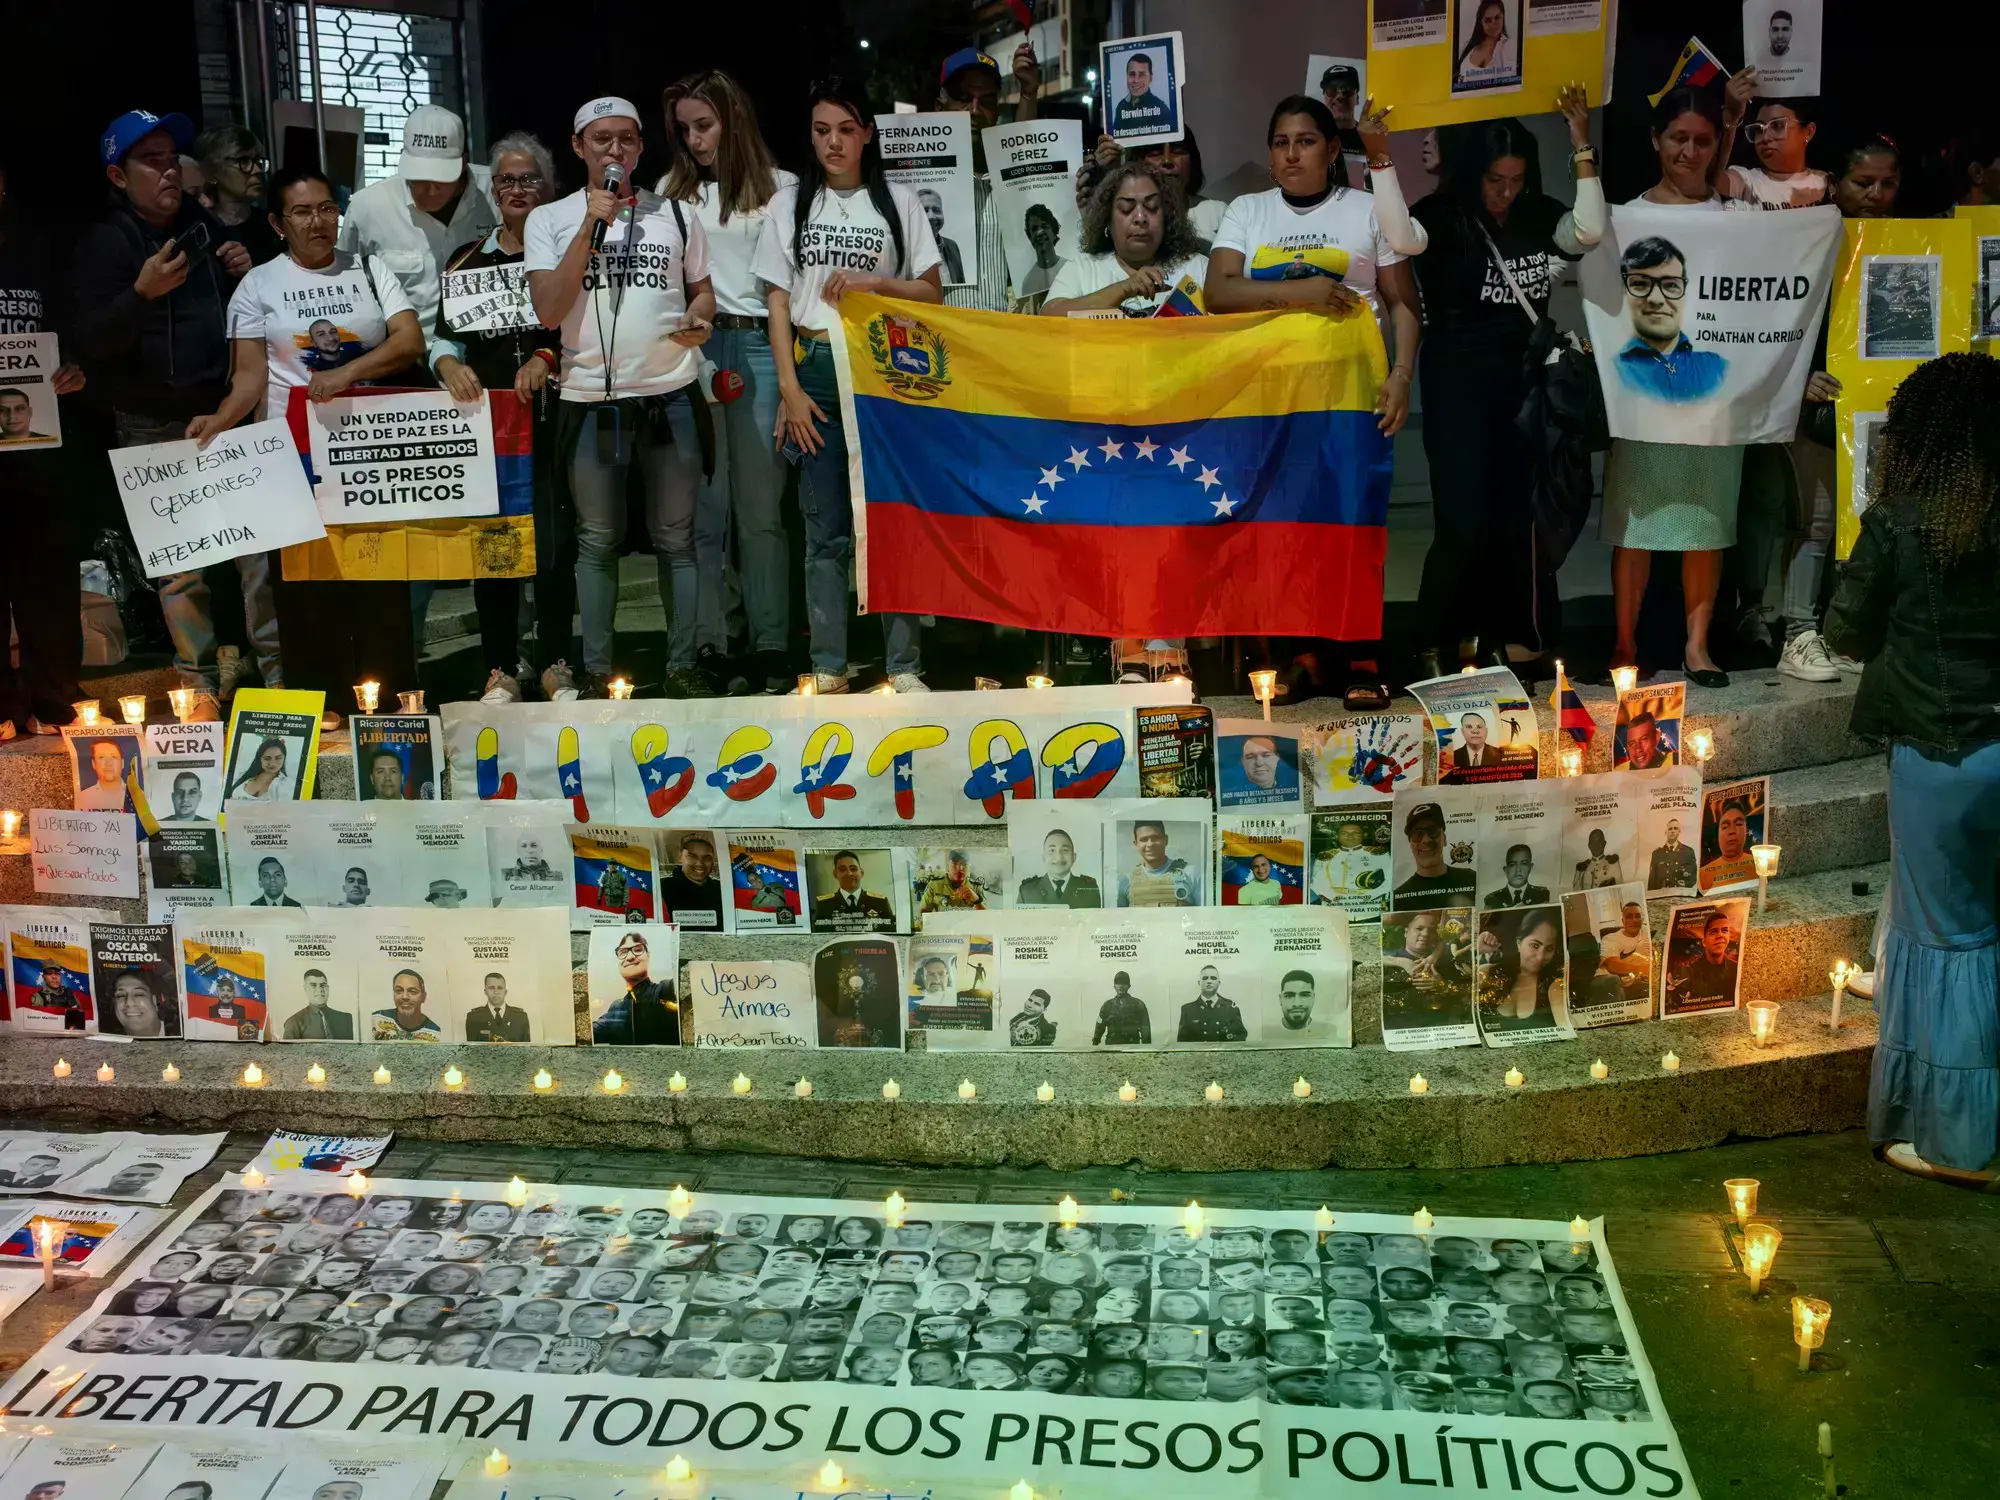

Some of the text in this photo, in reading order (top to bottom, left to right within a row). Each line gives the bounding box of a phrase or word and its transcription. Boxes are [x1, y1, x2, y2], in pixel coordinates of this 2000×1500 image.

[1122, 108, 1142, 119] Darwin
[878, 126, 952, 139] FERNANDO
[412, 134, 447, 149] PETARE
[1001, 132, 1058, 149] RODRIGO
[885, 142, 946, 154] SERRANO
[1011, 149, 1048, 162] PÉREZ
[840, 225, 884, 238] A TODOS
[633, 244, 670, 255] TODOS
[826, 234, 883, 253] PRESOS
[606, 255, 669, 270] PRESOS
[583, 270, 667, 291] OLÍTICOS
[284, 284, 360, 302] LIBEREN A
[1699, 276, 1810, 301] LIBERTAD
[298, 303, 353, 318] POLITICOS
[1697, 313, 1716, 321] PARA
[1696, 330, 1754, 343] JONATHAN
[341, 408, 460, 427] UN VERDADERO
[328, 423, 472, 443] ACTO DE PAZ ES LA
[330, 442, 476, 462] LIBERTAD DE TODOS
[123, 457, 188, 490] ¿DÓNDE
[255, 436, 284, 455] LOS
[341, 464, 465, 485] LOS PRESOS
[151, 467, 262, 524] GEDEONES?
[344, 483, 465, 506] POLÍTICOS
[1429, 702, 1460, 713] JUSTO
[360, 720, 425, 728] Ricardo Cariel
[1140, 714, 1177, 725] ES AHORA
[154, 725, 212, 735] JACKSON
[1149, 722, 1180, 732] NUNCA
[359, 732, 428, 745] ¡LIBERTAD!
[155, 739, 214, 754] VERA
[1143, 748, 1179, 760] LIBERTAD
[1144, 756, 1179, 766] PARA TODOS
[475, 718, 1126, 824] LIBERTAD
[1599, 802, 1618, 810] SILVA
[1673, 801, 1697, 809] PLAZA
[37, 817, 120, 835] LIBERTAD YA!
[27, 924, 59, 933] LIBEREN
[91, 926, 126, 934] EXIGIMOS
[201, 930, 235, 938] LIBEREN
[95, 933, 136, 941] INMEDIATA
[35, 940, 65, 949] POLITICOS
[107, 942, 148, 951] OSCAR
[210, 946, 242, 954] POLITICOS
[98, 951, 161, 962] GRATEROL
[701, 962, 777, 997] Jesus
[721, 996, 791, 1019] Armas
[1626, 999, 1648, 1007] ARROYO
[6, 1368, 1684, 1498] LIBERTAD PARA TODOS LOS PRESOS POLÍTICOS
